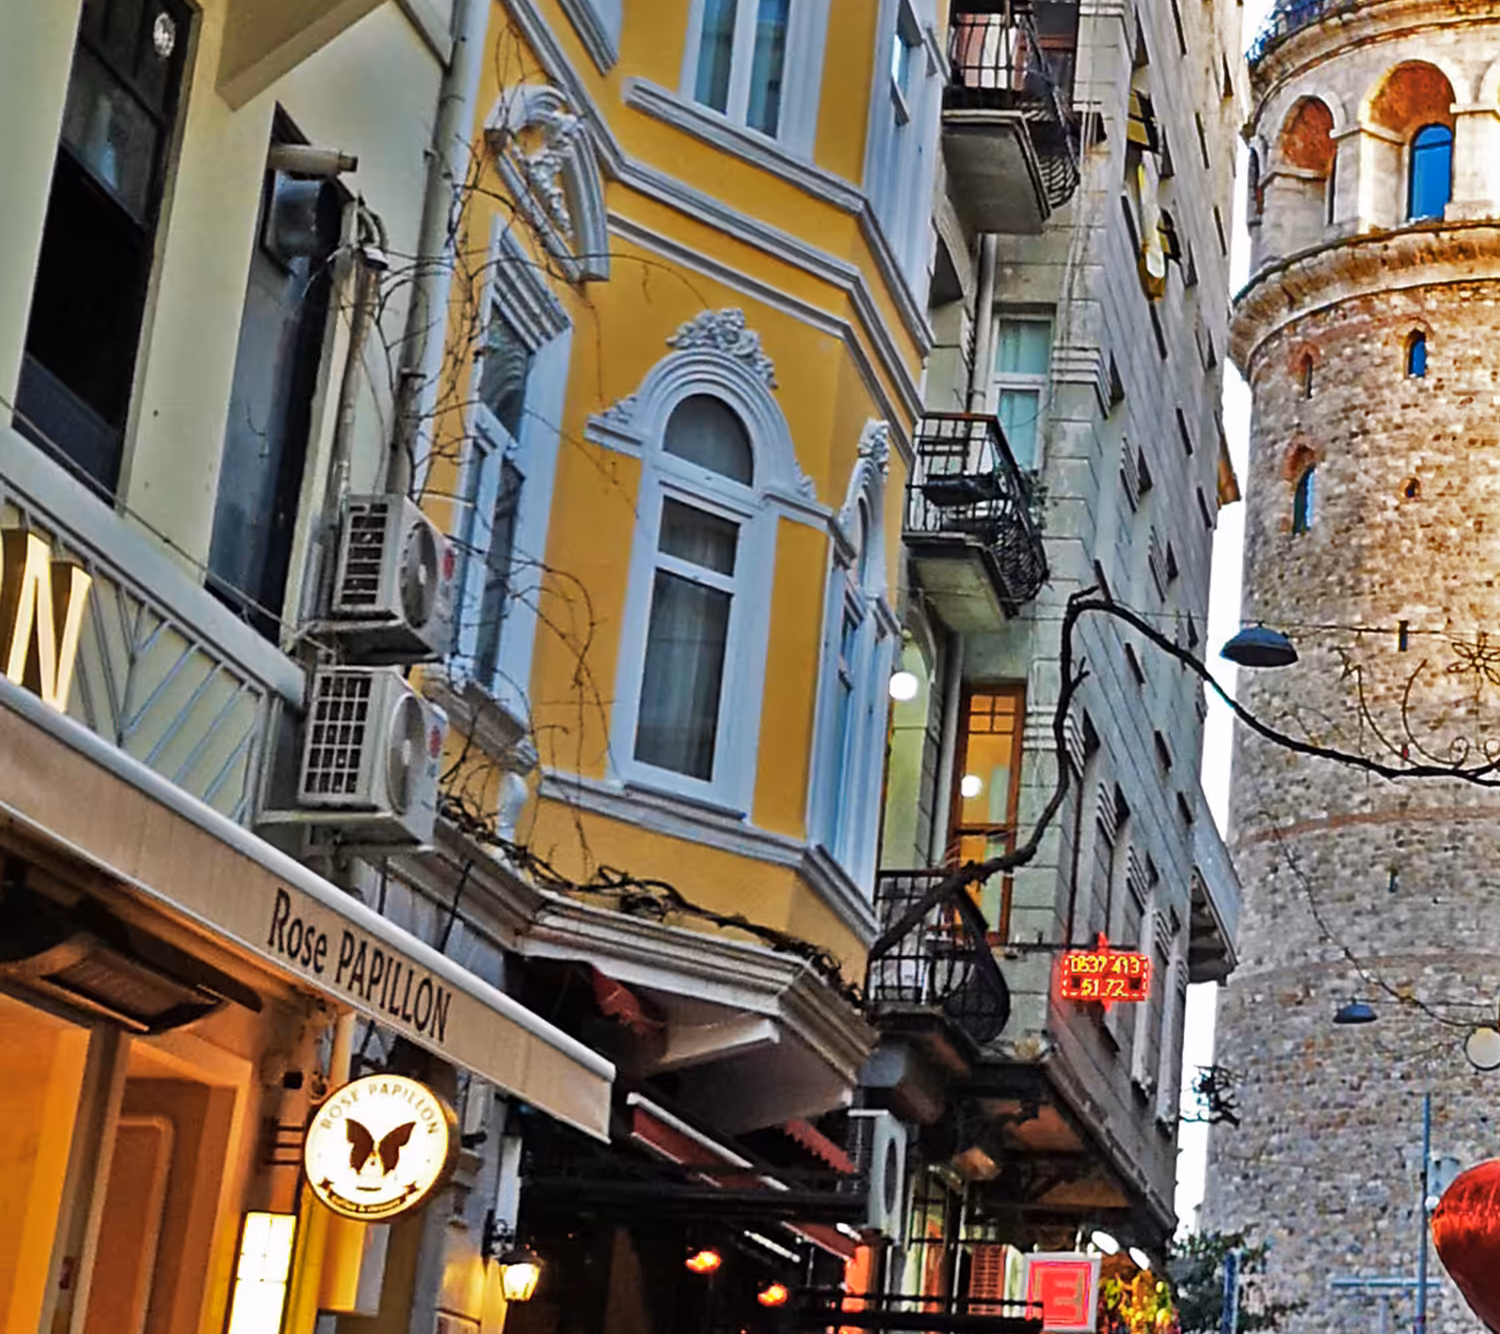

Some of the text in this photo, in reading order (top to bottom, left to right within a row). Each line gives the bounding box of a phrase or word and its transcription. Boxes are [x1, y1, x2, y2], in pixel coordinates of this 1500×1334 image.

[0, 529, 93, 714] N
[267, 886, 452, 1043] Rose PAPILLON
[368, 1082, 440, 1135] PAPILLON
